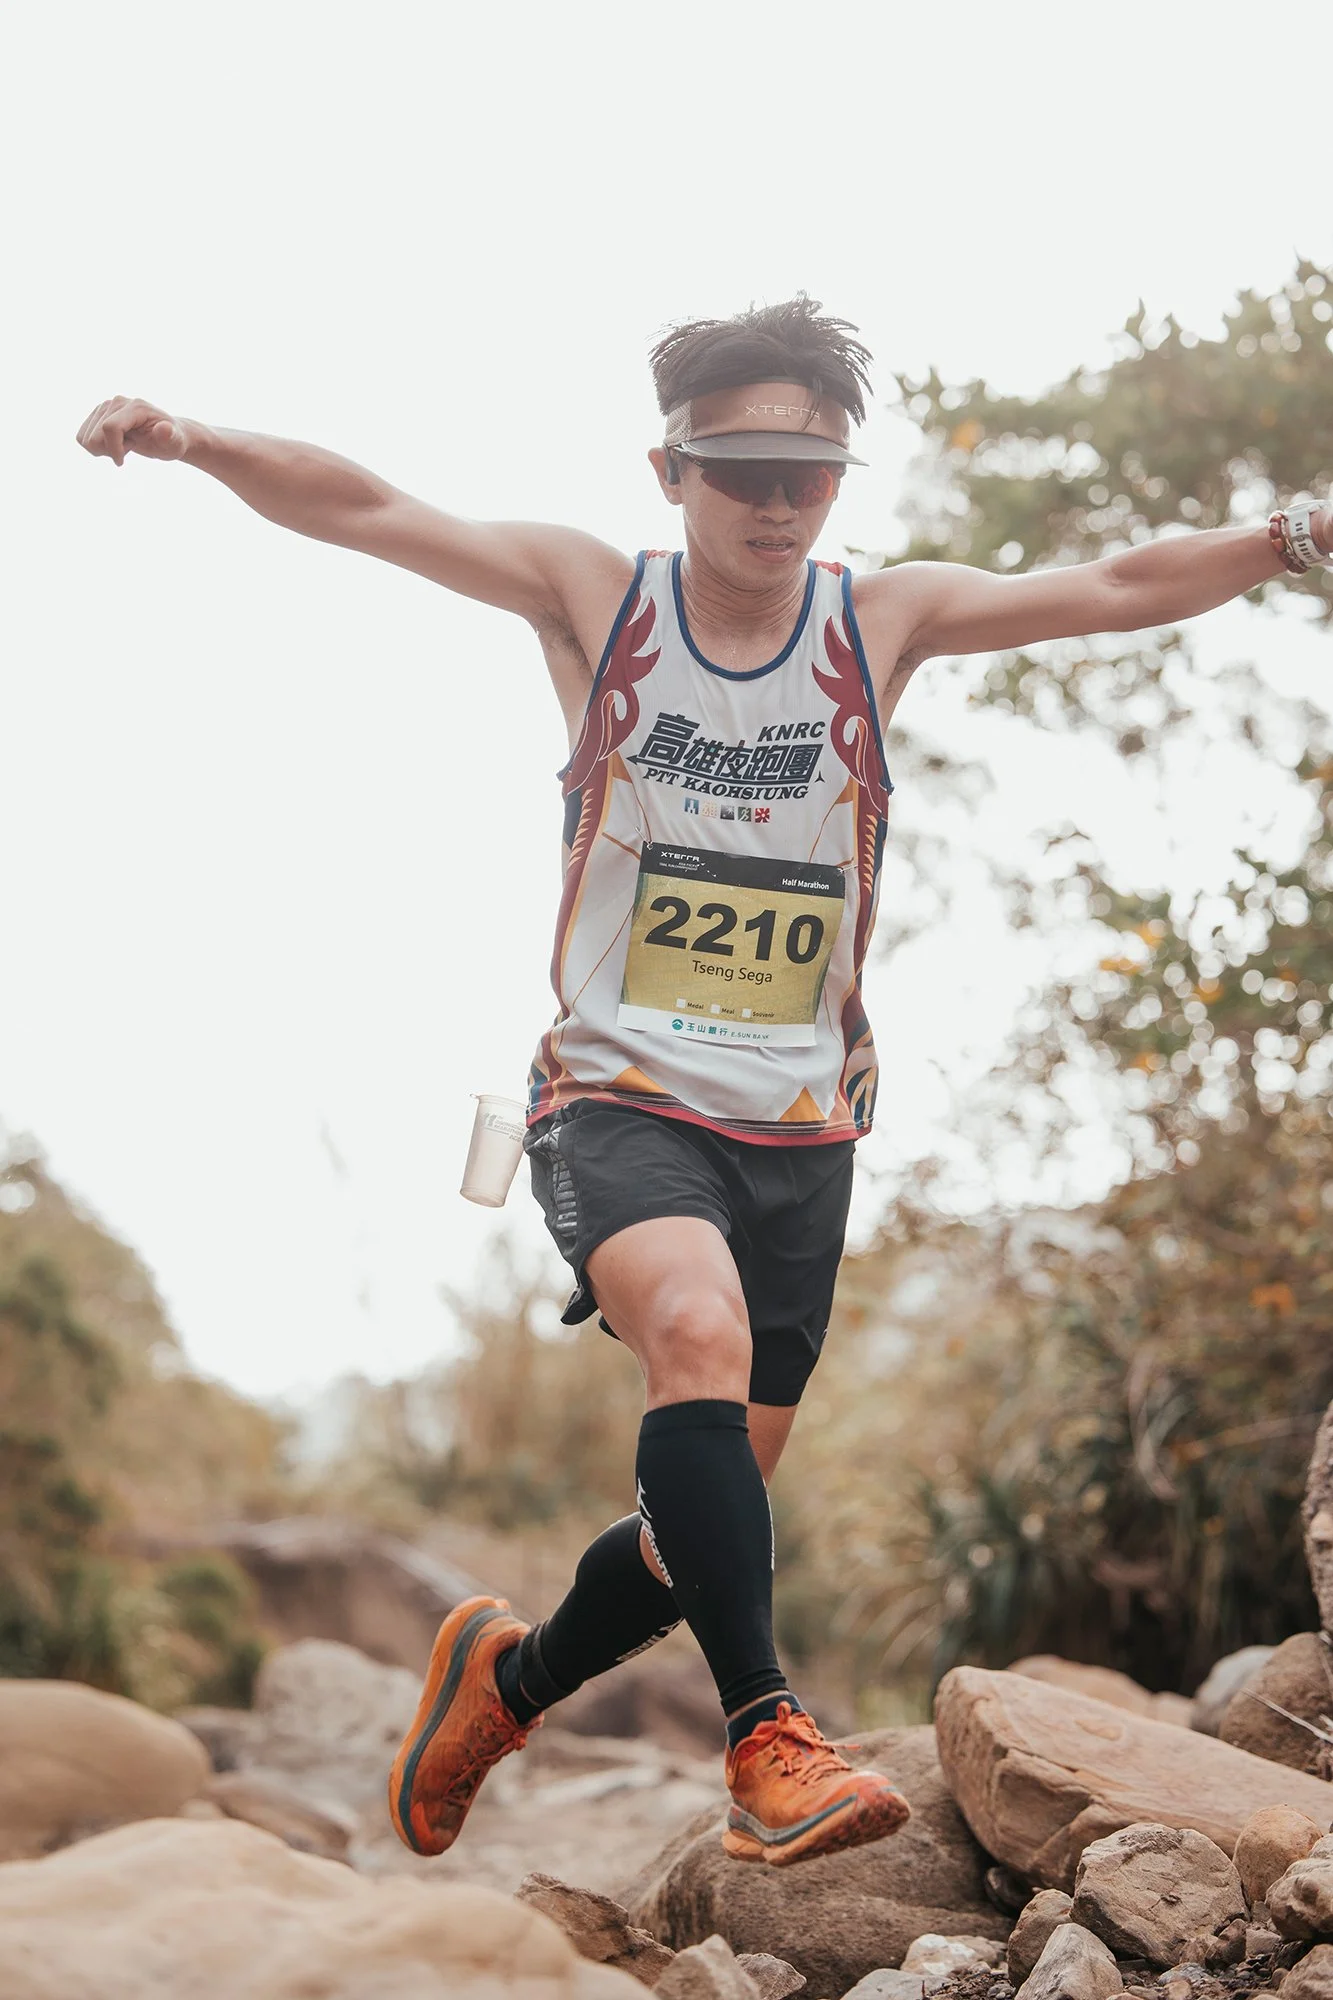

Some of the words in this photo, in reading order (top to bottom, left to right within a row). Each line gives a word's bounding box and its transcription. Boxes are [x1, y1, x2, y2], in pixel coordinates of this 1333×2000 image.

[745, 405, 821, 420] XTERRA
[757, 721, 826, 742] KNRC
[638, 712, 824, 783] 高雄夜跑團
[643, 768, 680, 785] PTT
[681, 775, 809, 800] KAOHSIUNG
[660, 851, 700, 862] XTERRA
[782, 878, 797, 887] Half
[798, 880, 830, 890] Marathon
[644, 895, 825, 965] 2210
[692, 960, 734, 981] Tseng
[738, 967, 773, 985] Sega
[687, 1002, 704, 1010] Medal
[686, 1022, 728, 1036] 玉山銀行
